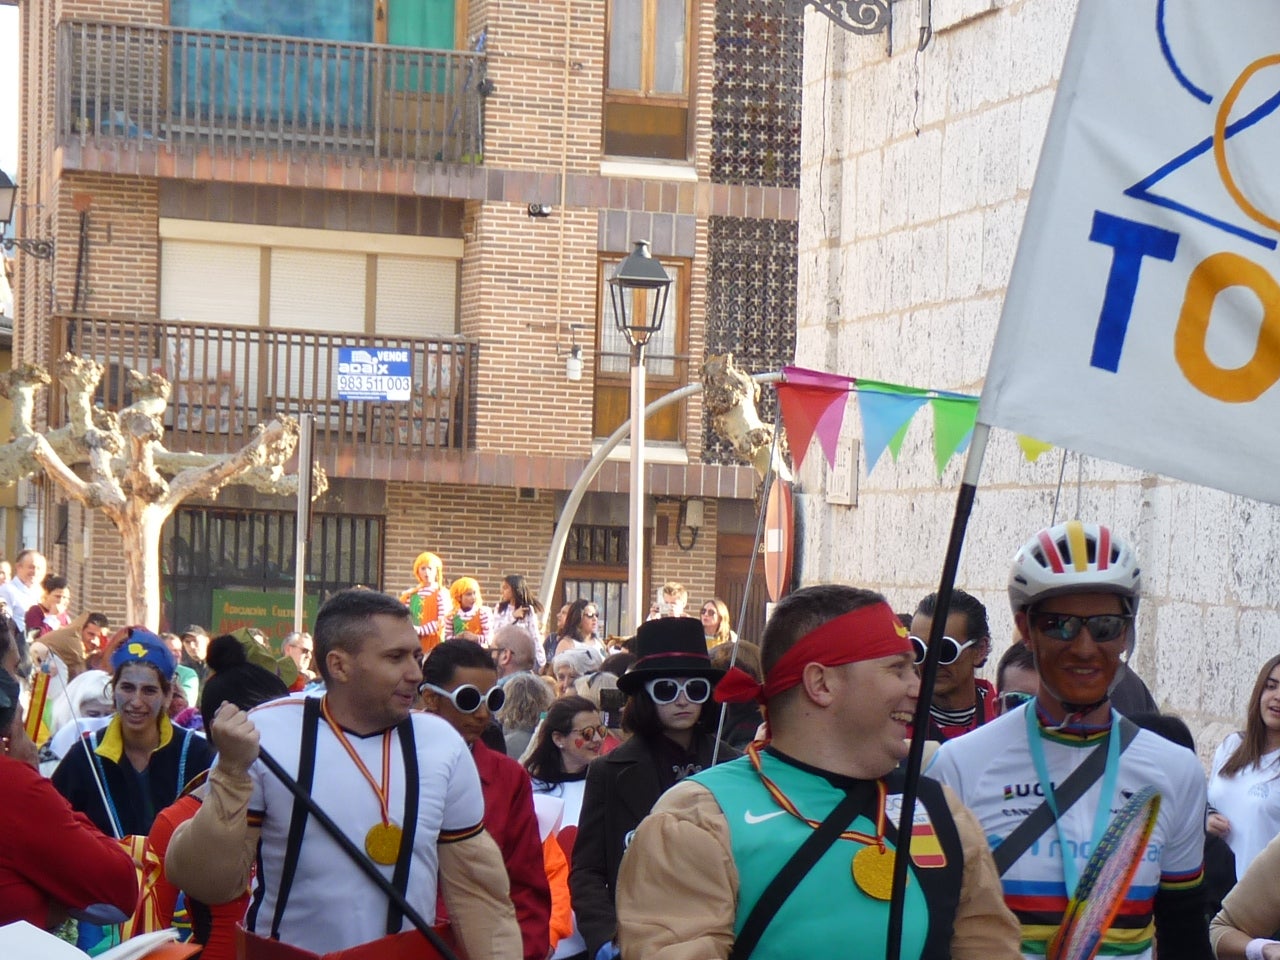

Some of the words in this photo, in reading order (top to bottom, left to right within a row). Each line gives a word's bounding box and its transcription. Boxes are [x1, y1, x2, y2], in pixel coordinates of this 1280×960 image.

[377, 350, 408, 362] VENDE
[340, 376, 363, 390] 983
[366, 377, 383, 391] 511
[386, 377, 410, 391] 003
